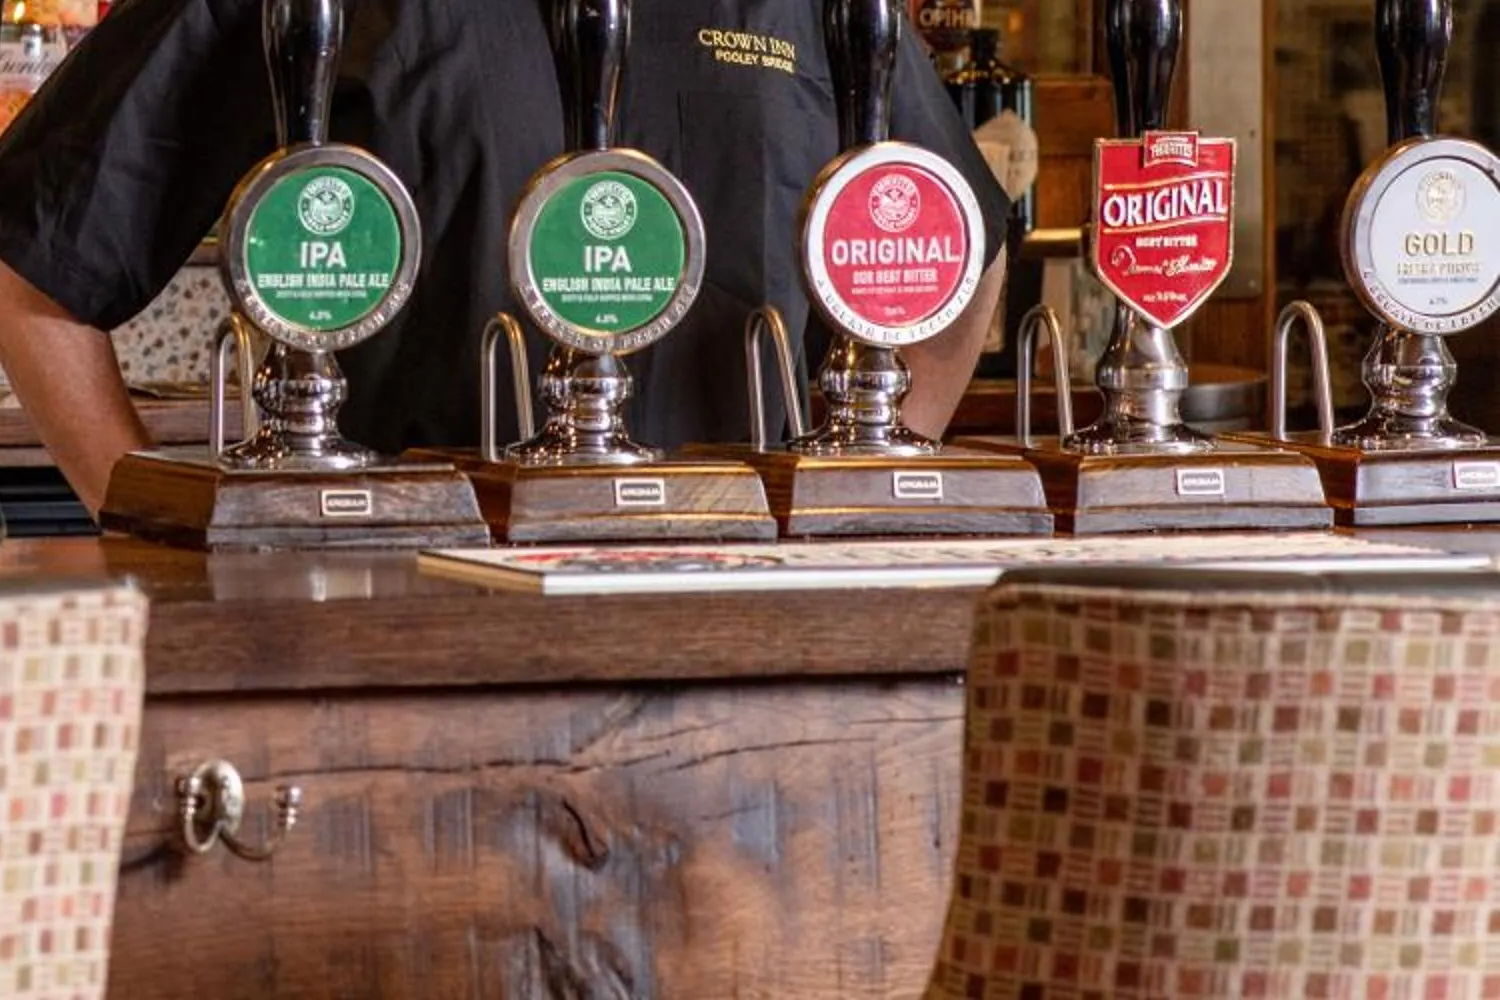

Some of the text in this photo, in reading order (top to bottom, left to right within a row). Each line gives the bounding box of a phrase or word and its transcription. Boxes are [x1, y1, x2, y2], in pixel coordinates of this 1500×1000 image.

[698, 29, 796, 61] CROWN INN
[715, 49, 759, 65] POOLEY
[1102, 178, 1229, 228] ORIGINAL
[300, 241, 348, 269] IPA
[831, 236, 961, 266] ORIGINAL
[1405, 231, 1474, 257] GOLD
[584, 245, 633, 273] IPA
[257, 273, 304, 289] ENGLISH
[339, 273, 366, 288] PALE
[367, 273, 390, 288] ALE
[542, 277, 676, 293] ENGLISH INDIA PALE ALE
